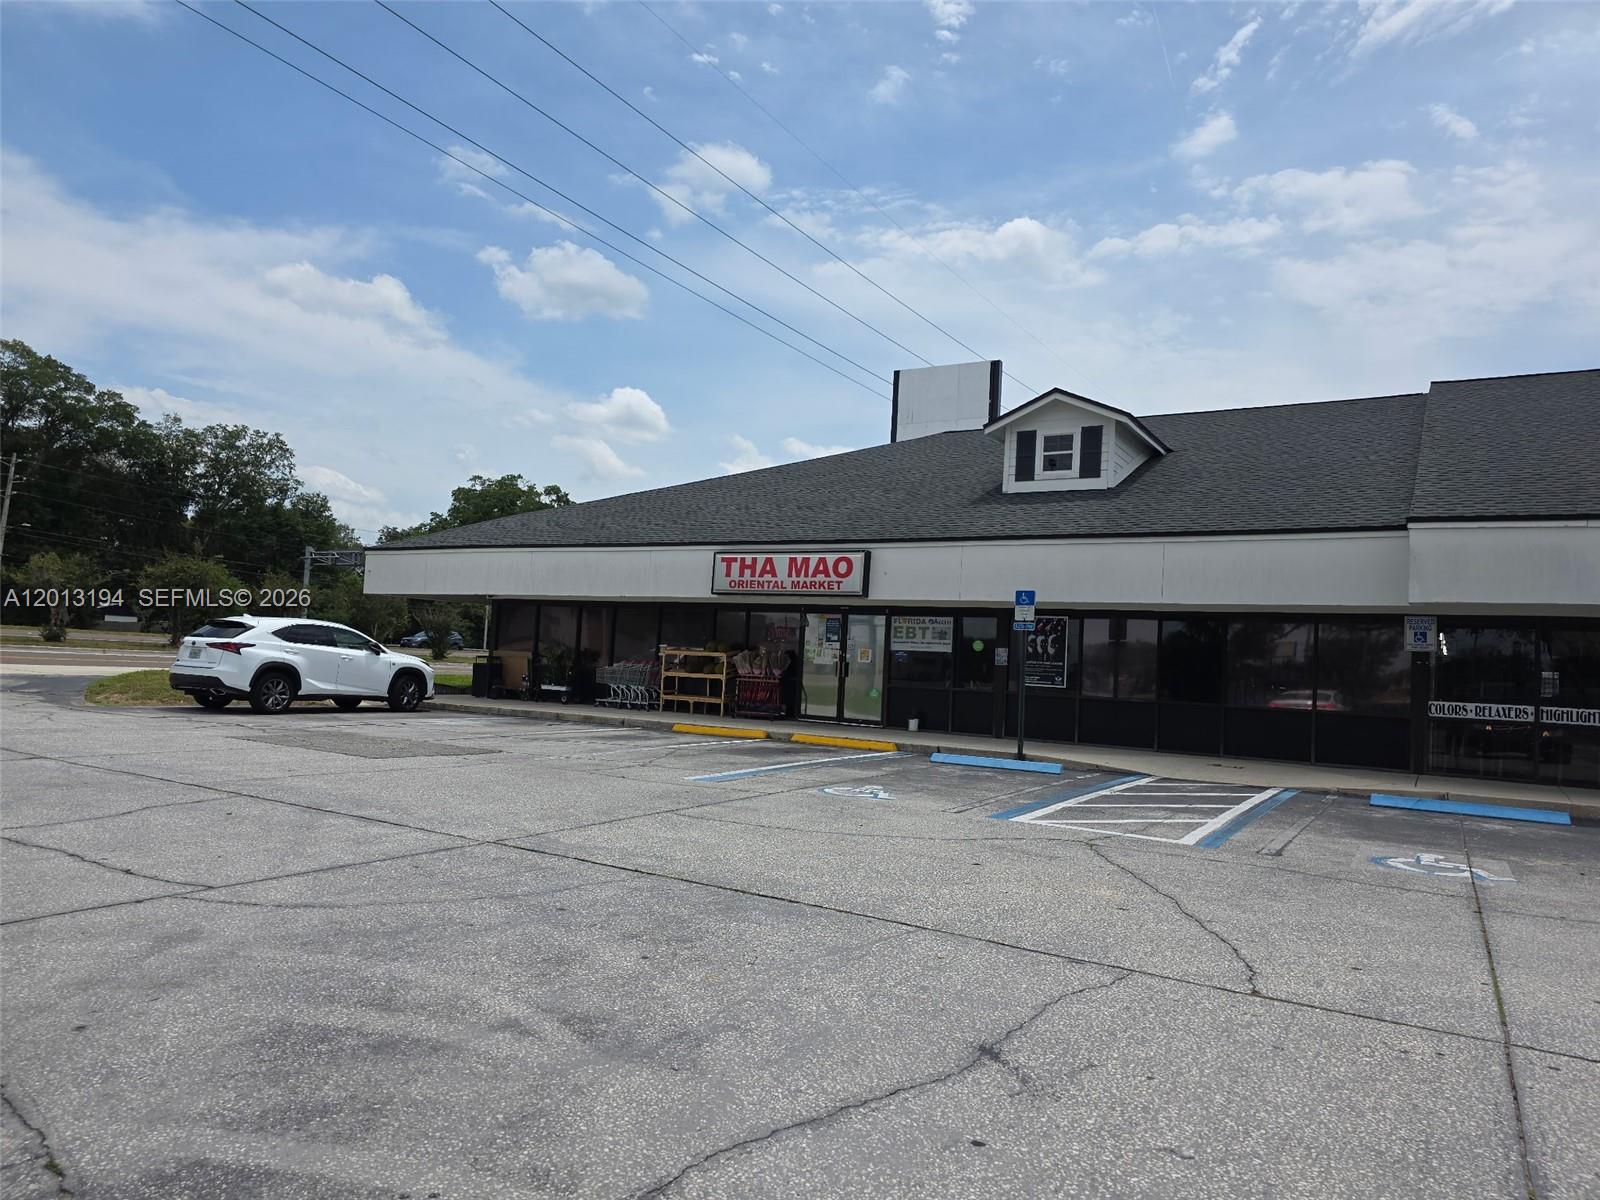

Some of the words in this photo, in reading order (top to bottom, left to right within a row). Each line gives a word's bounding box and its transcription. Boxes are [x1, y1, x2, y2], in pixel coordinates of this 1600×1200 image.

[720, 556, 778, 578] THA
[787, 556, 854, 579] MAO
[728, 580, 787, 590] ORIENTAL
[790, 580, 843, 591] MARKET
[1406, 617, 1435, 625] RESERVED
[893, 625, 930, 640] EBT
[1428, 702, 1469, 717] COLORS
[1474, 705, 1529, 720] RELAXERS
